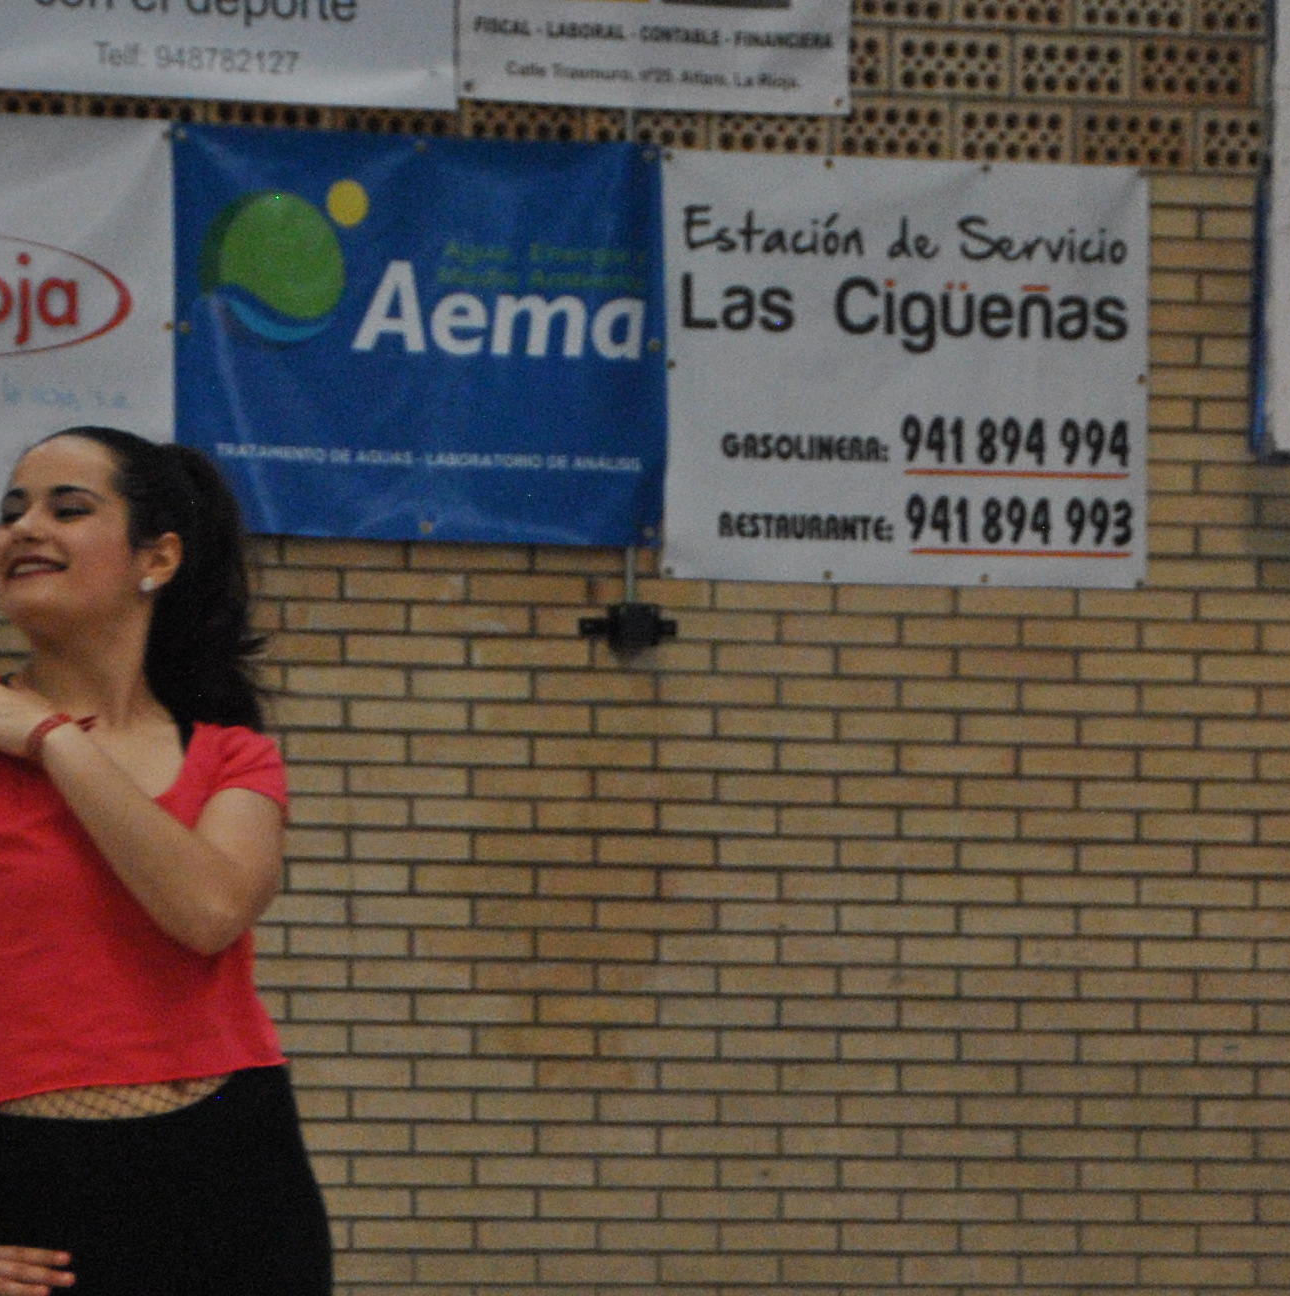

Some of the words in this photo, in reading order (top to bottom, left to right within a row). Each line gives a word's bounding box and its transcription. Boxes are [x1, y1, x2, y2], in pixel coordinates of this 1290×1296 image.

[155, 44, 302, 74] 948782127
[473, 16, 531, 37] FISCAL
[547, 23, 625, 41] LABORAL
[640, 26, 720, 46] CONTABLE
[735, 32, 833, 50] FINANCIERA
[683, 204, 864, 257] Estación
[887, 217, 939, 260] de
[957, 215, 1127, 265] Servicio
[351, 258, 646, 361] Aema
[681, 272, 795, 333] Las
[834, 276, 1128, 354] Cigüeñas
[721, 433, 888, 462] GASOLINERA:
[902, 415, 963, 463] 941
[977, 417, 1045, 465] 894
[1060, 419, 1129, 467] 994
[719, 512, 893, 541] RESTAURANTE:
[906, 494, 968, 543] 941
[982, 497, 1051, 544] 894
[1066, 498, 1133, 547] 993
